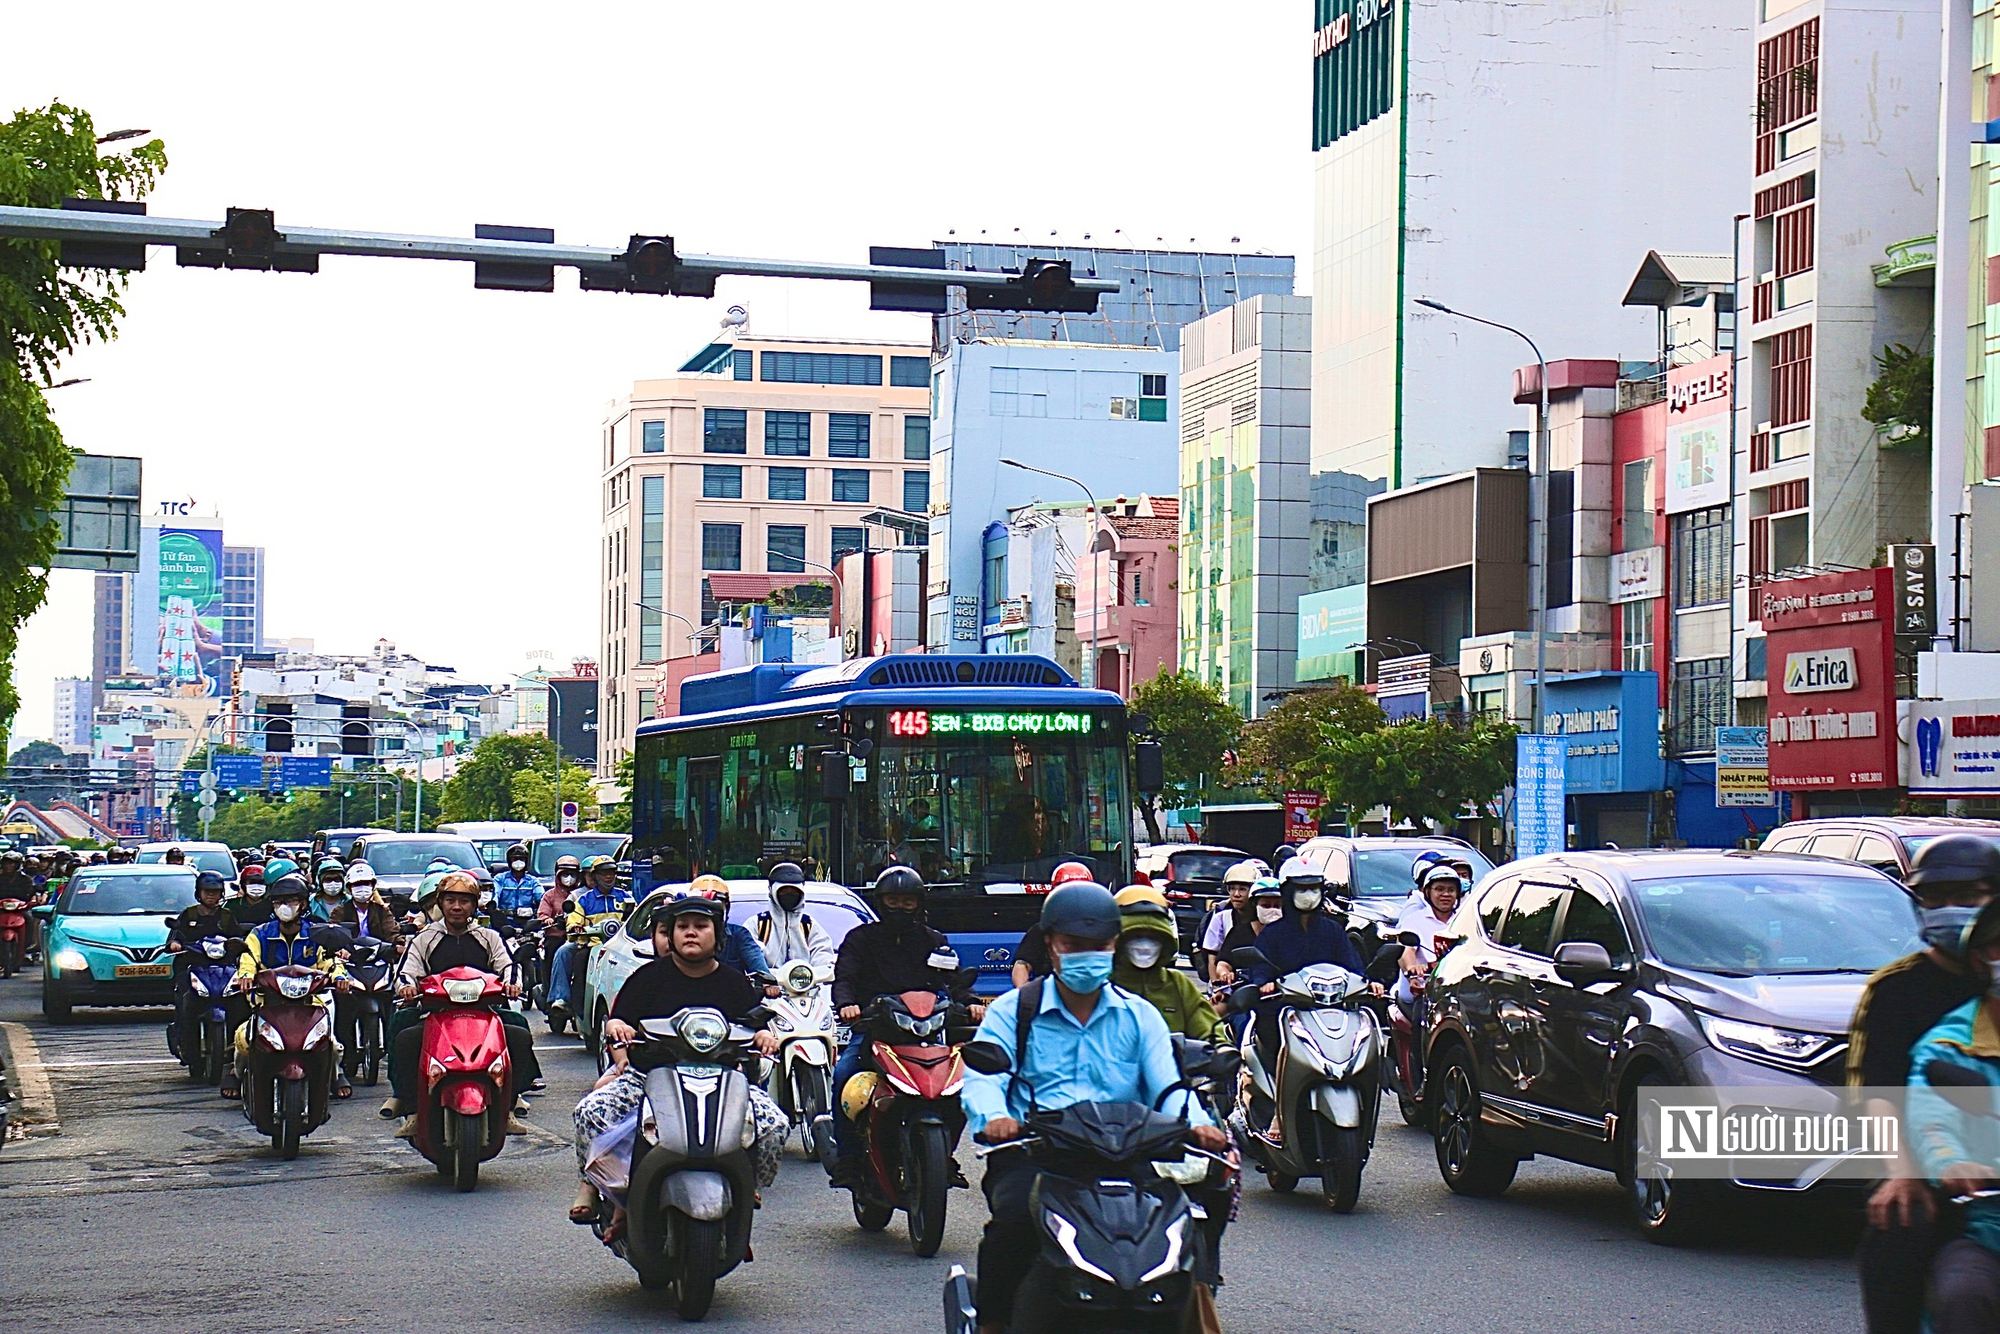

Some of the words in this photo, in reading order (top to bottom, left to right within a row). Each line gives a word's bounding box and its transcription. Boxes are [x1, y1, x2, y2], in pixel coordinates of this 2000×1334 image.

[160, 501, 188, 516] TTC
[161, 550, 176, 561] Từ
[177, 551, 196, 562] fan
[185, 562, 207, 575] bạn
[1906, 570, 1925, 608] SAY
[956, 596, 977, 605] ANH
[1906, 613, 1927, 628] 24h
[957, 632, 973, 640] EM
[525, 649, 555, 660] HOTEL
[1806, 655, 1849, 687] Erica
[890, 711, 928, 735] 145
[972, 715, 1005, 732] BXB
[1007, 713, 1043, 733] CHỢ
[1045, 711, 1082, 732] LỚN
[1563, 707, 1593, 734] THÀNH
[1594, 704, 1619, 731] PHÁT
[1517, 765, 1544, 781] CỘNG
[1545, 764, 1565, 779] HÒA
[1720, 773, 1746, 783] NHẬT
[1291, 829, 1318, 838] 150.000
